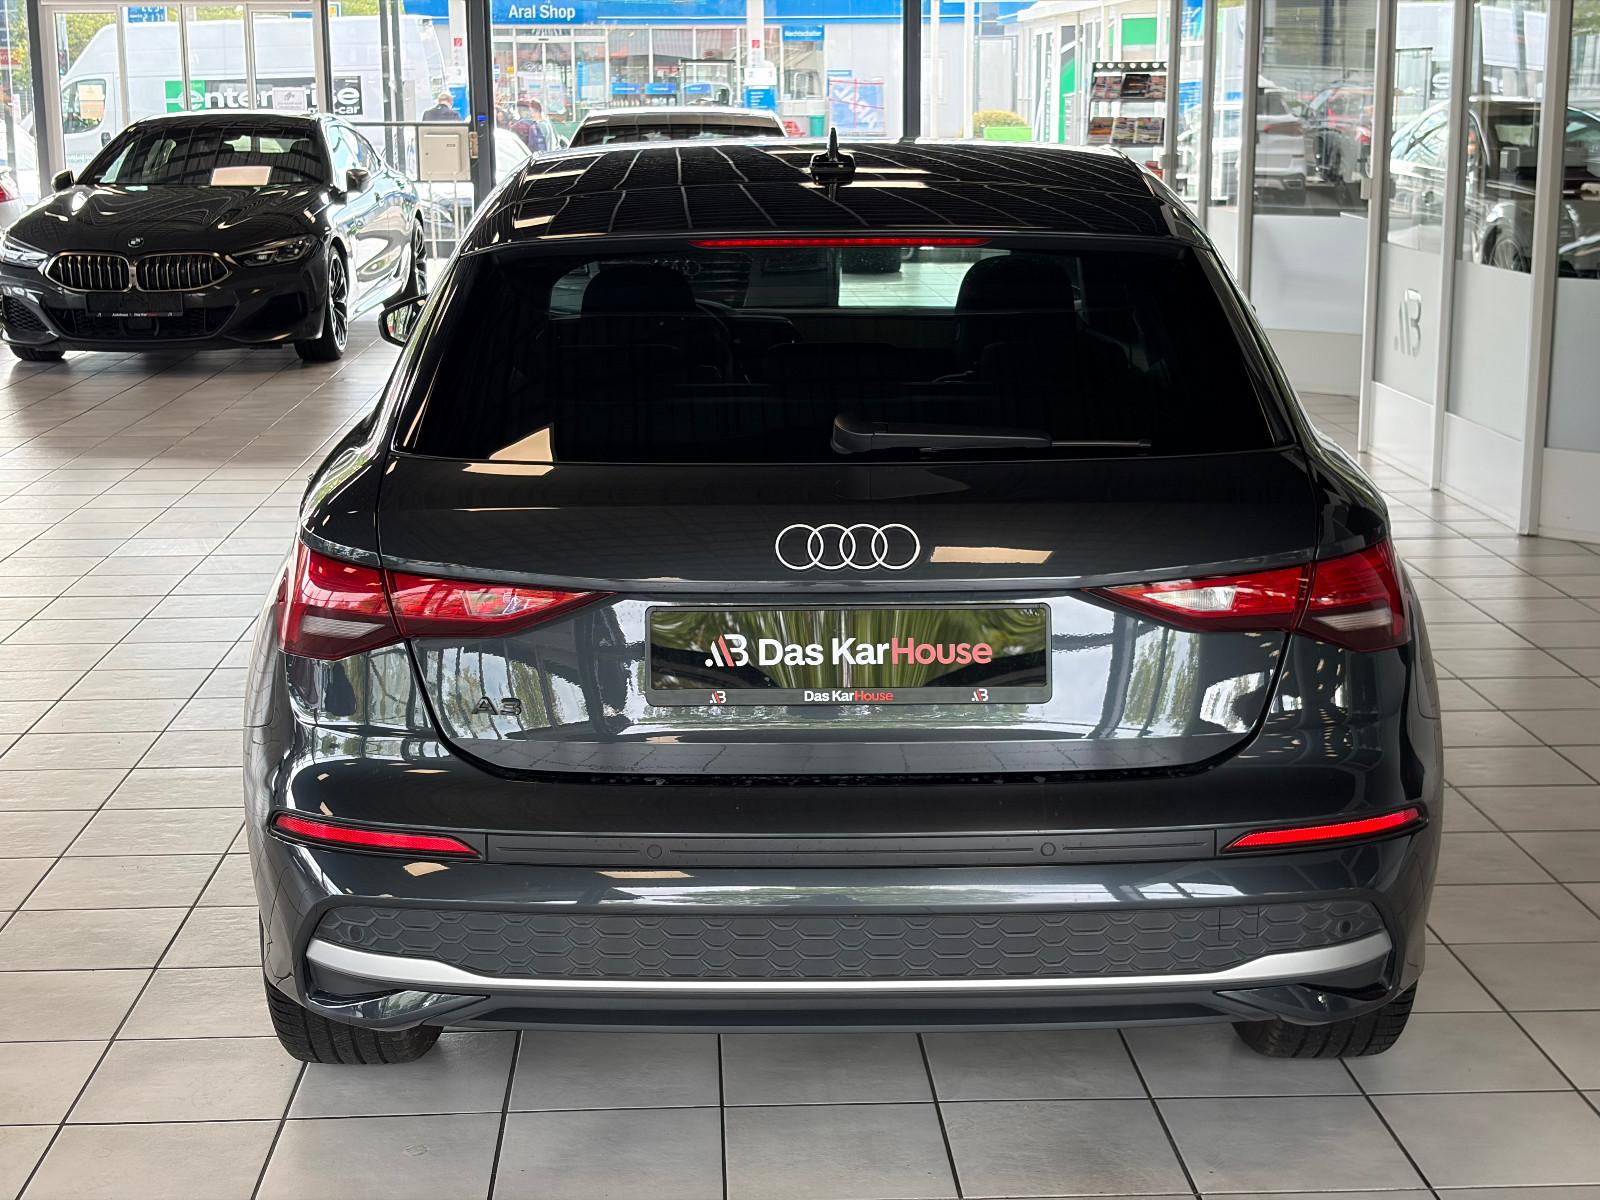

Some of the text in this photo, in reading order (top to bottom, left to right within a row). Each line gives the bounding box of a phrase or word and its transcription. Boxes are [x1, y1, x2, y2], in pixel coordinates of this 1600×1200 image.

[508, 4, 576, 21] Aral Shop
[758, 638, 824, 666] Das
[831, 637, 993, 665] KarHouse
[804, 690, 894, 702] Das KarHouse
[472, 696, 522, 716] A3
